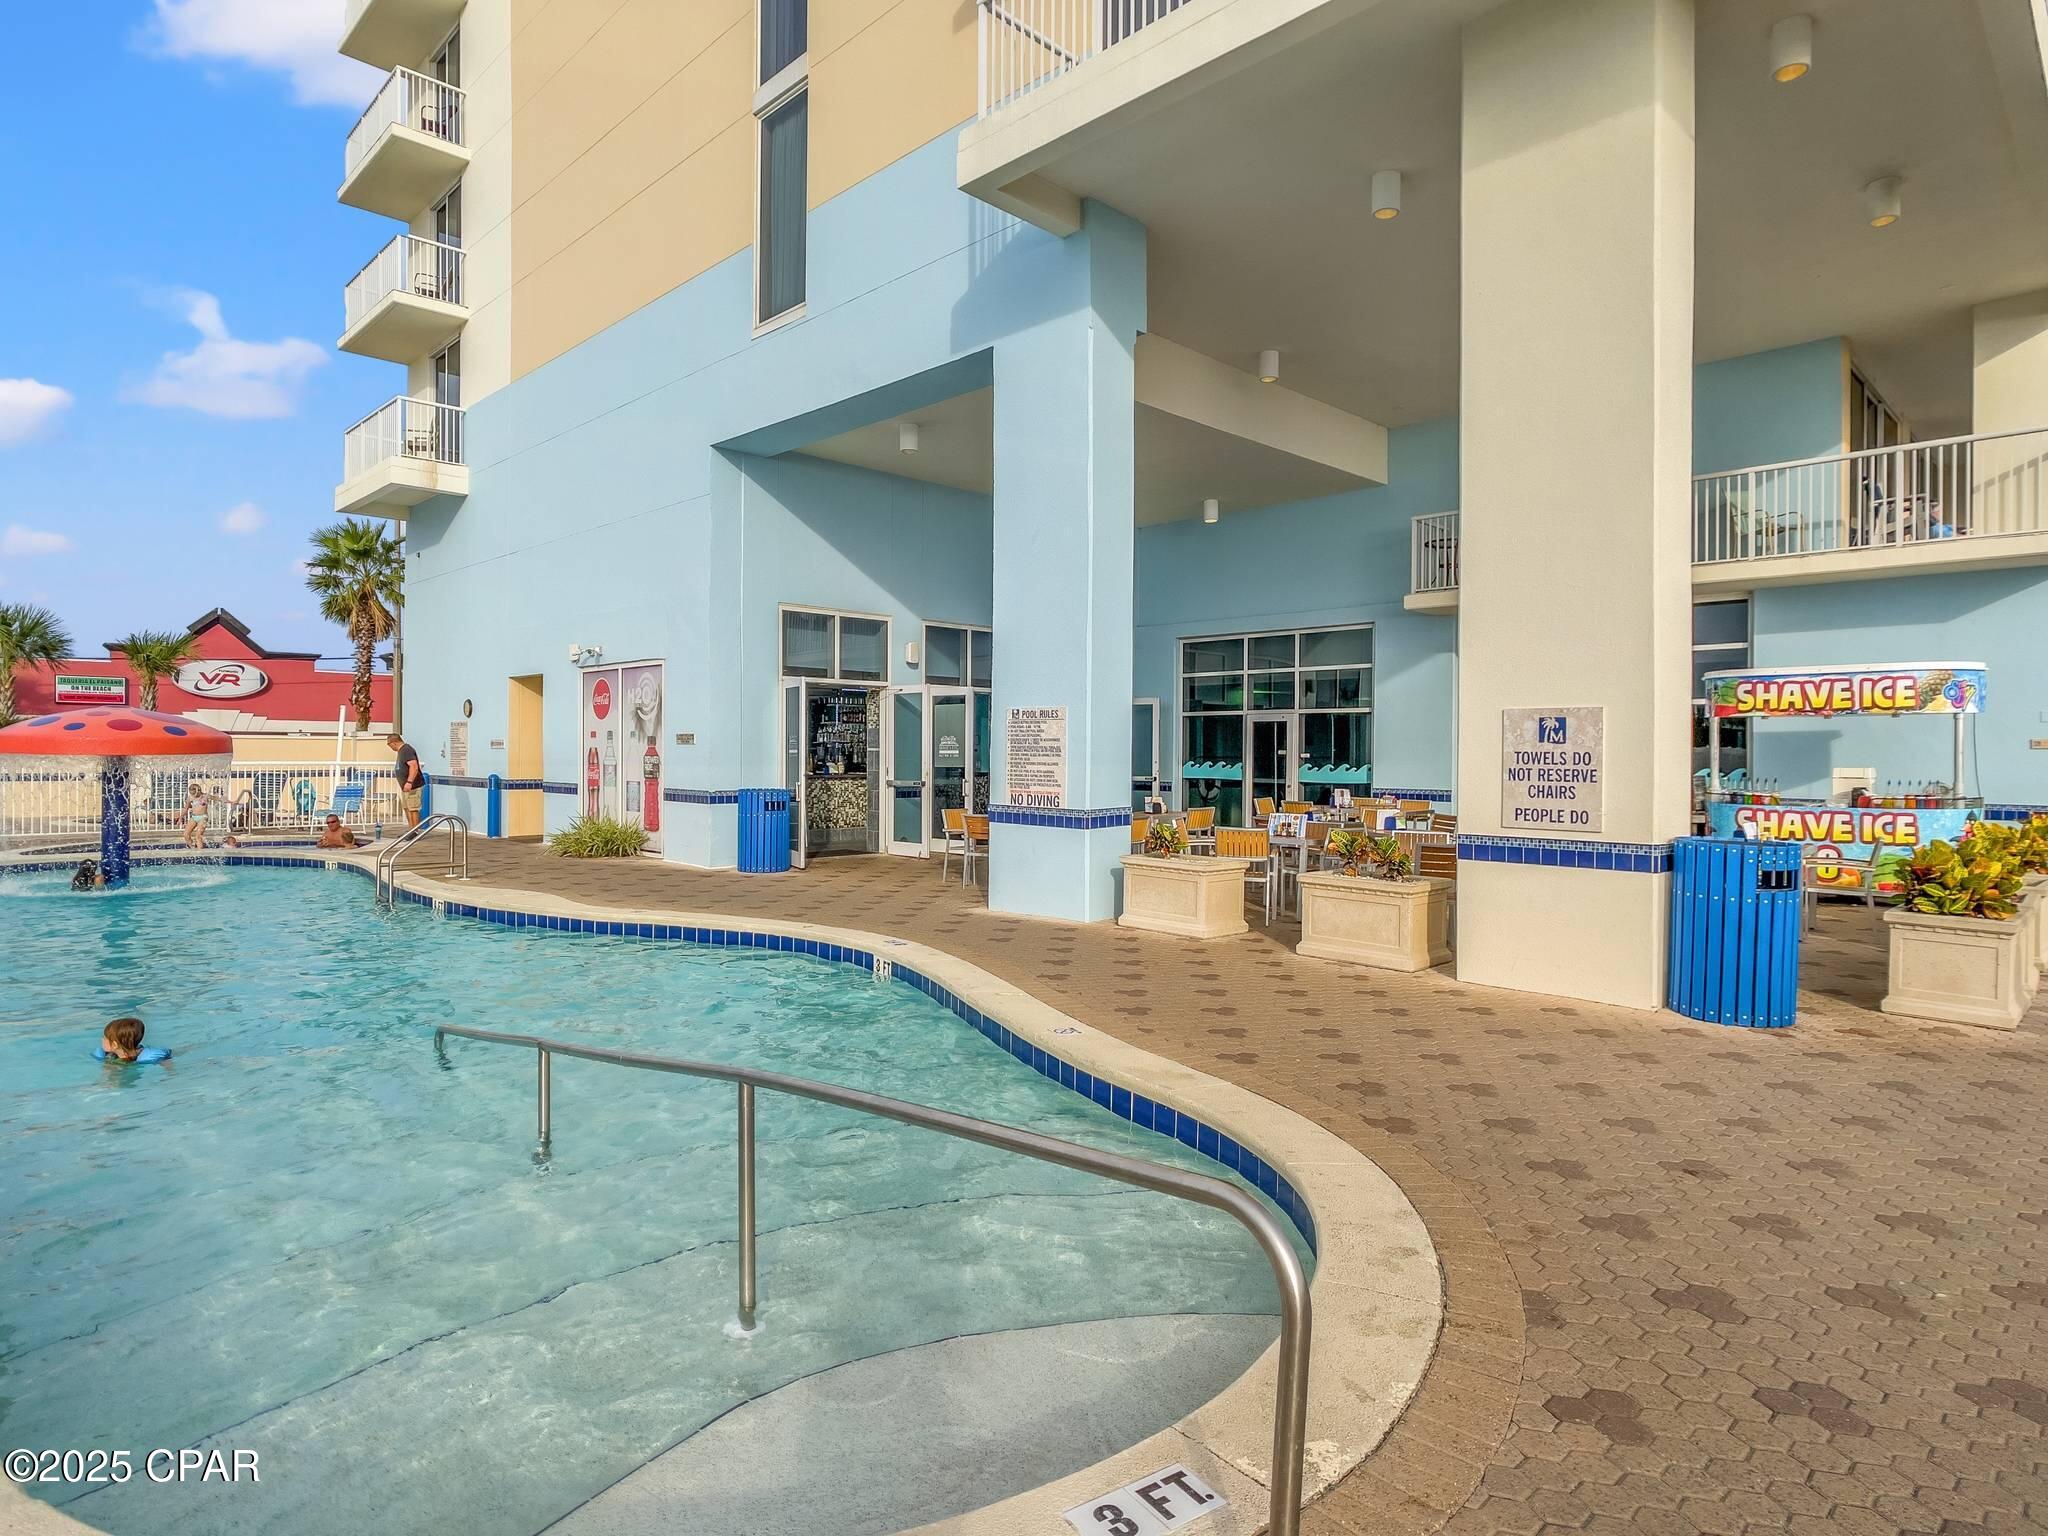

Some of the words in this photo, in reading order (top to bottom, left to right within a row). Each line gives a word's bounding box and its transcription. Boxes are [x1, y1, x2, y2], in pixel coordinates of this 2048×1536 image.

[199, 671, 241, 687] VR
[1736, 680, 1854, 712] SHAVE
[1859, 676, 1918, 711] ICE
[1021, 710, 1037, 719] POOL
[1040, 710, 1059, 719] RULES
[1514, 751, 1567, 765] TOWELS
[1573, 752, 1592, 766] DO
[1508, 768, 1533, 782] NOT
[1538, 768, 1598, 783] RESERVE
[1010, 794, 1024, 805] NO
[1027, 794, 1060, 807] DIVING
[1528, 785, 1576, 800] CHAIRS
[1515, 807, 1565, 823] PEOPLE
[1570, 810, 1589, 824] DO
[1859, 812, 1918, 845] ICE
[876, 958, 881, 972] 3
[883, 960, 891, 976] FT
[1092, 1504, 1140, 1536] 3
[1135, 1470, 1215, 1521] FT.
